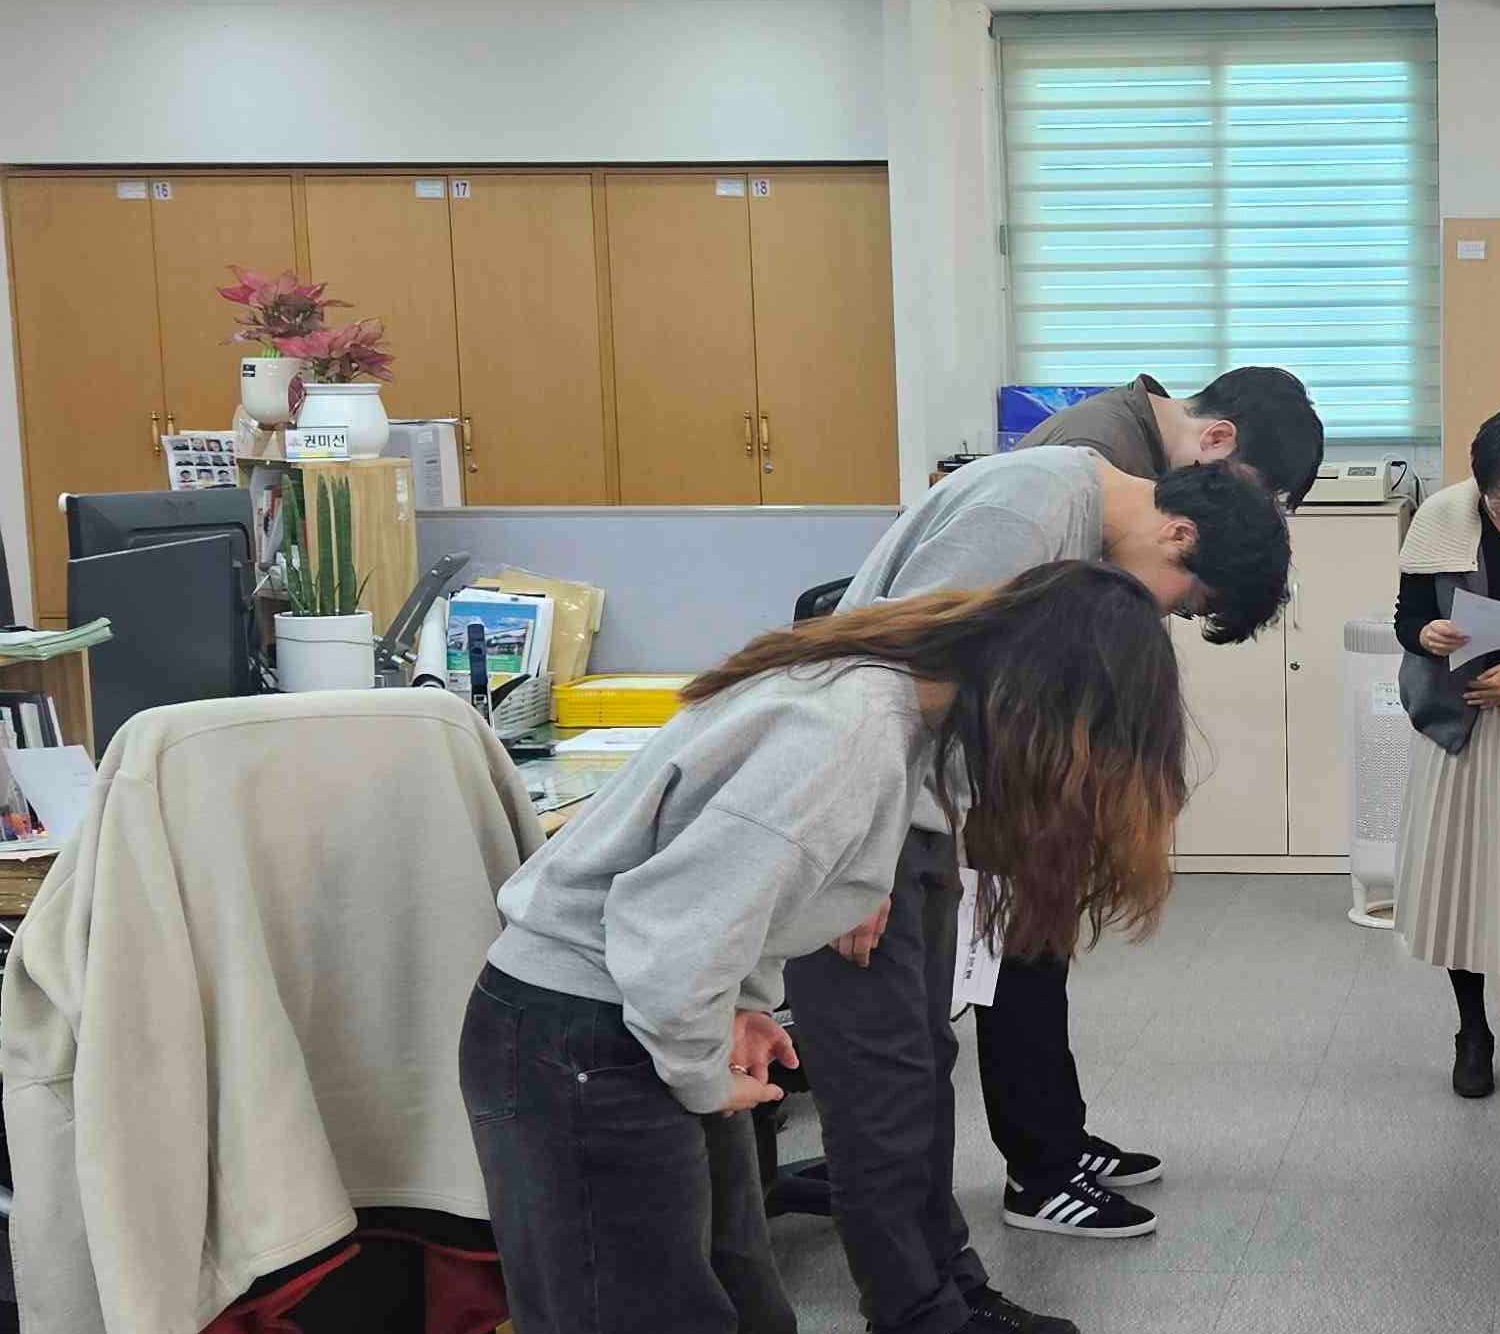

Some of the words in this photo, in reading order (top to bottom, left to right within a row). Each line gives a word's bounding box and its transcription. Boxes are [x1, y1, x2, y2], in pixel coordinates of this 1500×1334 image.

[455, 182, 468, 196] 17
[755, 180, 768, 195] 18
[303, 434, 345, 448] 권미선
